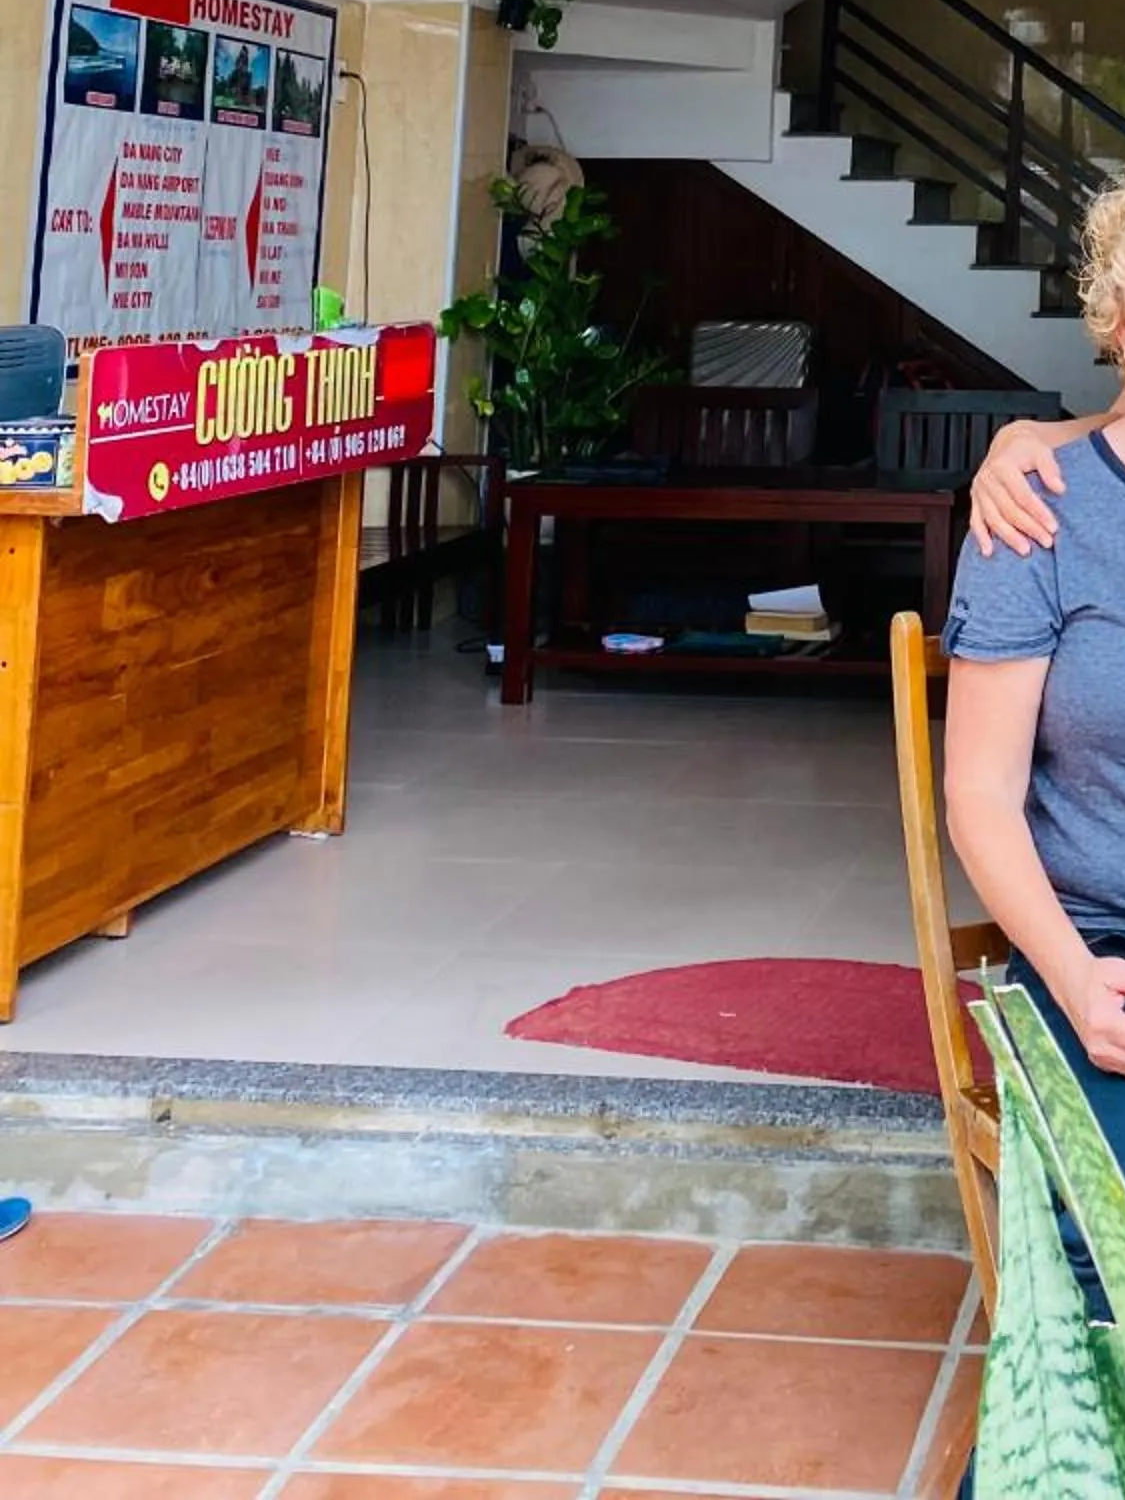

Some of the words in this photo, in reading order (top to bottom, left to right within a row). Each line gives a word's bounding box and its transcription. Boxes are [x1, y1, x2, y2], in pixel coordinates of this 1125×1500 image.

[52, 208, 73, 233] CAR
[77, 209, 93, 234] TO:
[97, 391, 191, 430] HOMESTAY
[248, 447, 272, 477] 504
